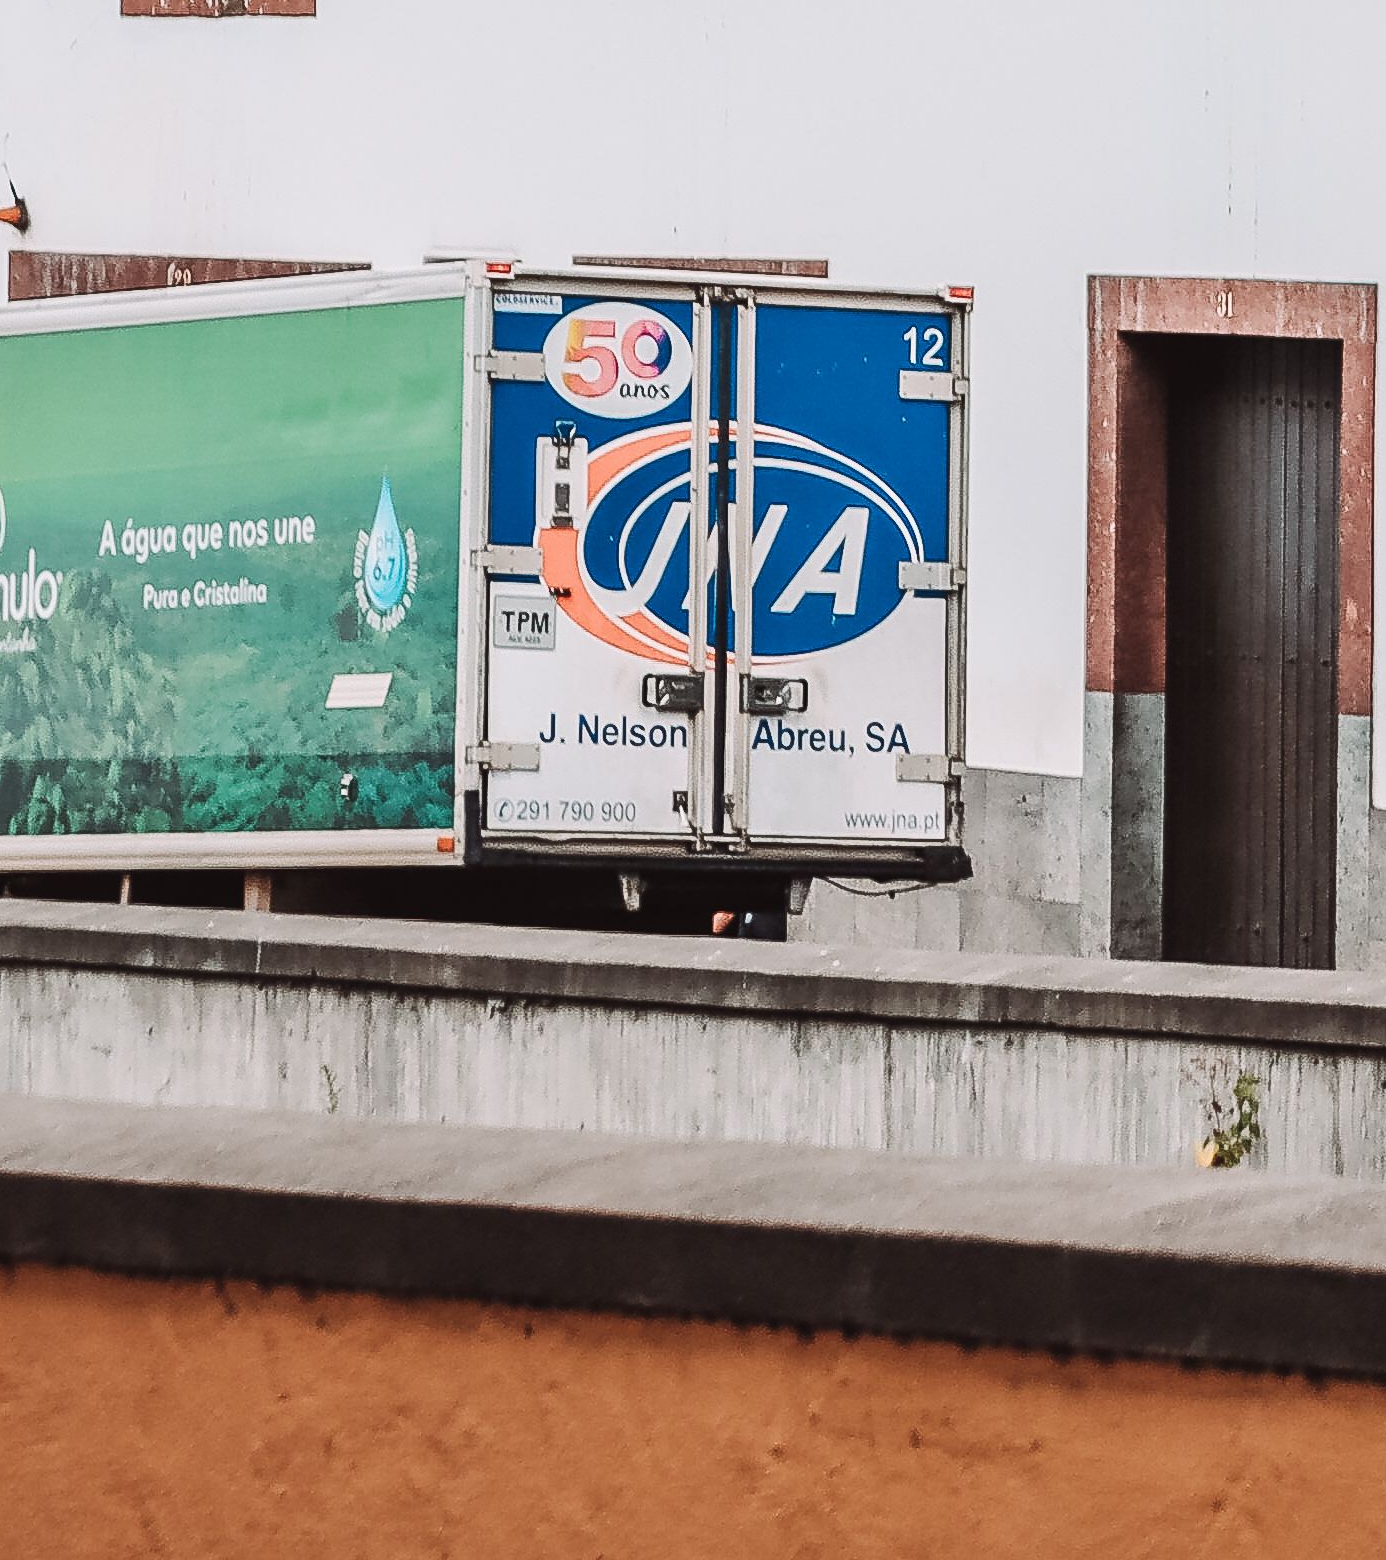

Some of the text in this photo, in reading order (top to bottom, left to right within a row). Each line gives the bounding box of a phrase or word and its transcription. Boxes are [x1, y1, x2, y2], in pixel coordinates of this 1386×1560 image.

[563, 319, 673, 398] 50
[903, 326, 944, 366] 12
[619, 382, 671, 399] anos
[98, 515, 316, 564] A água que nos une
[143, 575, 268, 610] Pura e Cristalina
[501, 610, 550, 634] TPM
[539, 712, 910, 757] J. Nelson Abreu, SA
[516, 800, 636, 822] 291 790 900
[845, 809, 941, 834] www.jna.pt
